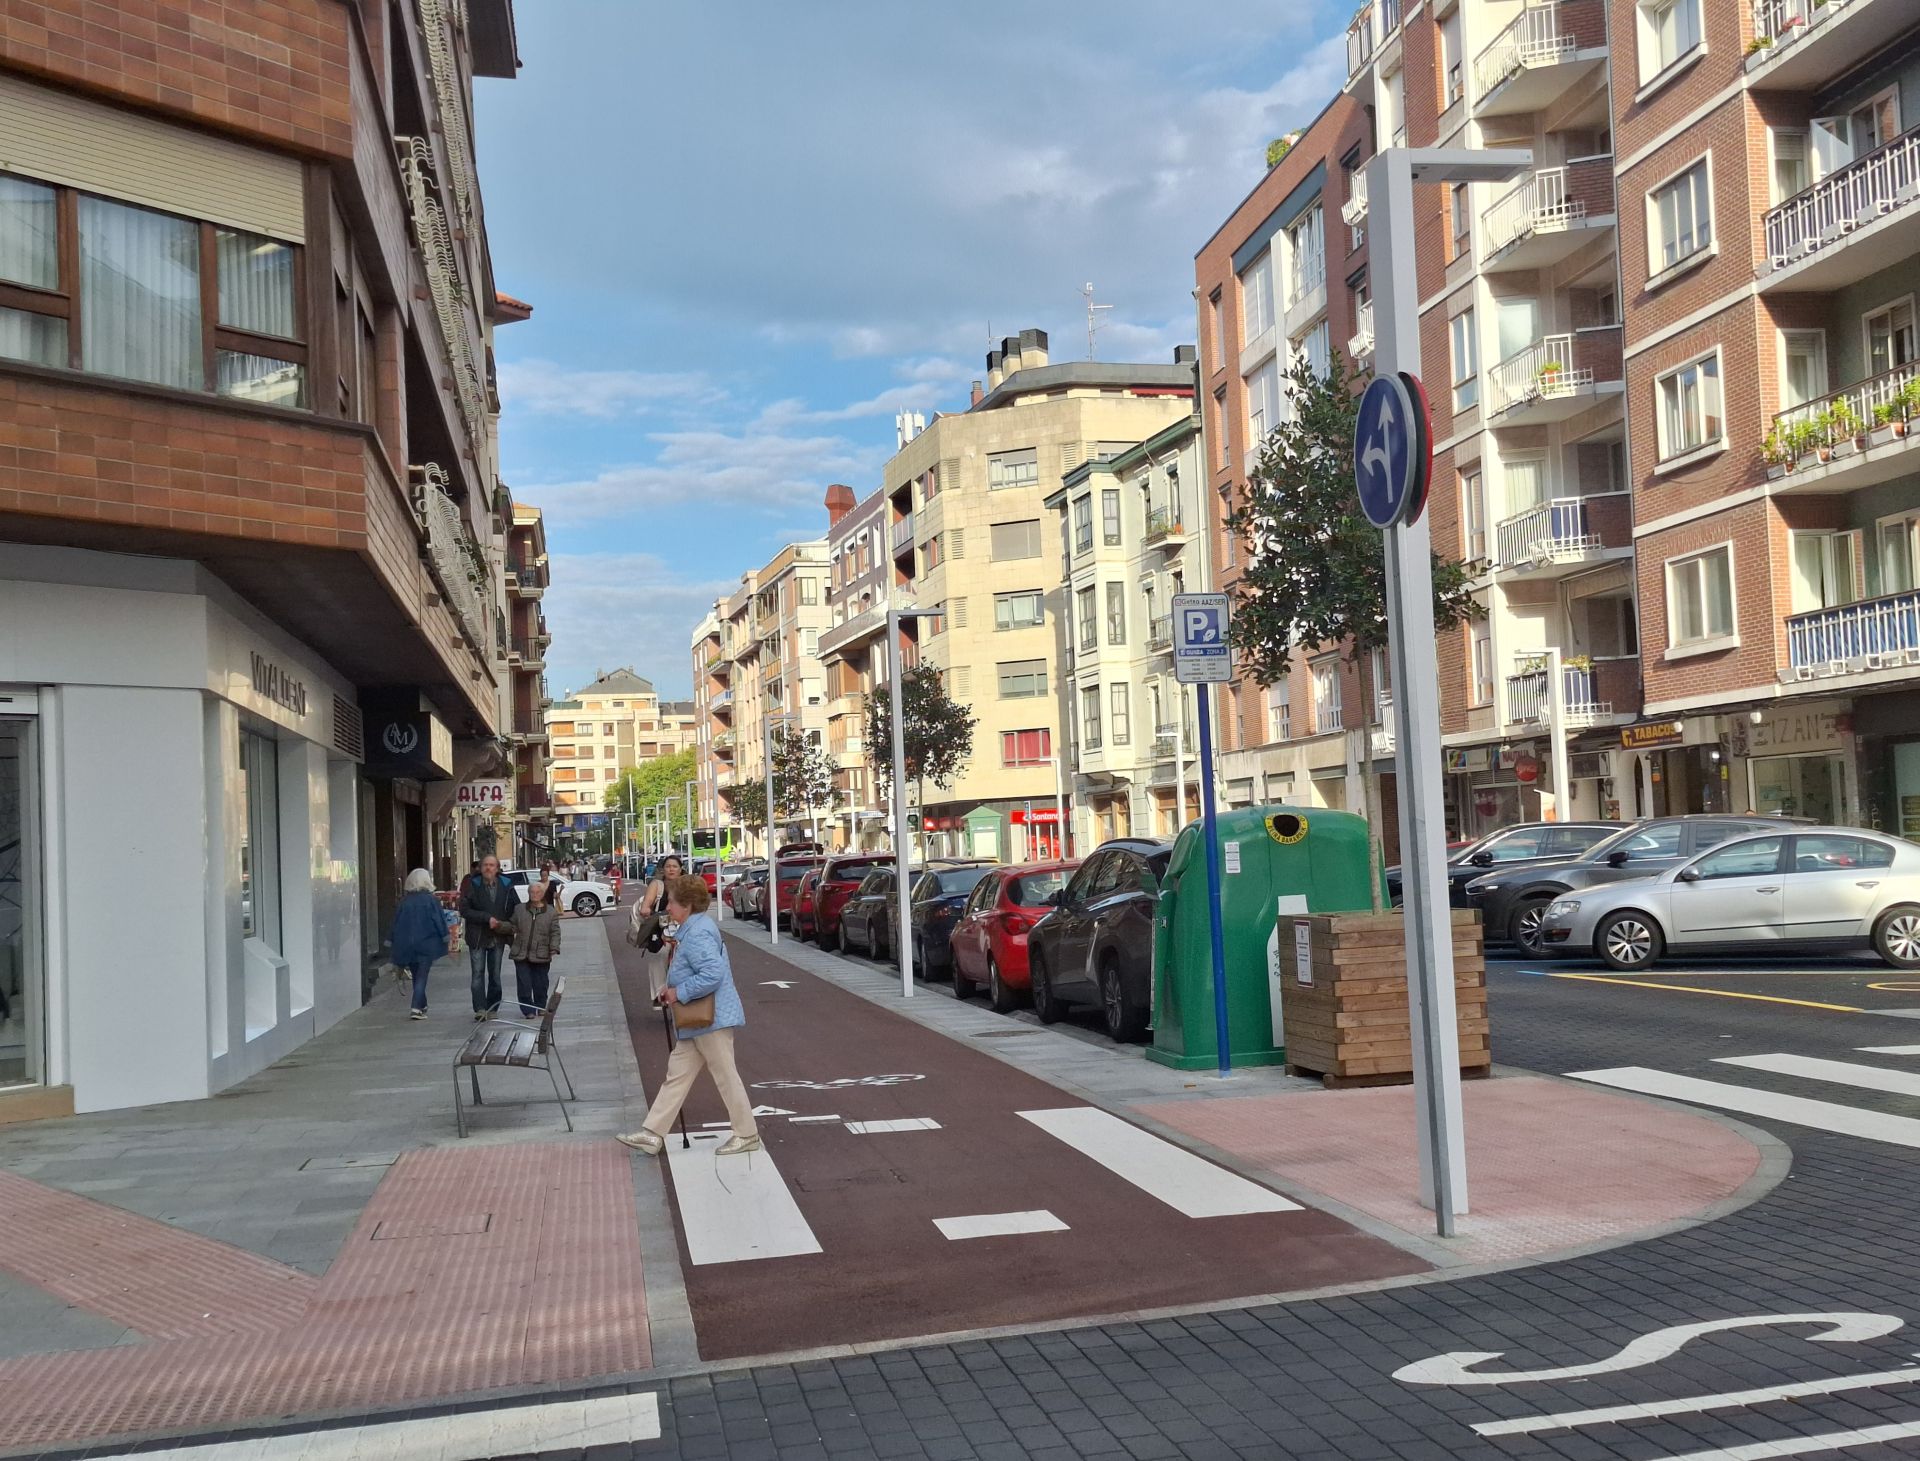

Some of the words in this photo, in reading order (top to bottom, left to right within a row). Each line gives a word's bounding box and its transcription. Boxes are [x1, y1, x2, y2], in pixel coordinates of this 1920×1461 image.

[1186, 611, 1209, 641] P
[1633, 723, 1677, 740] TABACOS
[457, 785, 503, 802] ALFA
[1031, 812, 1068, 821] Santanr
